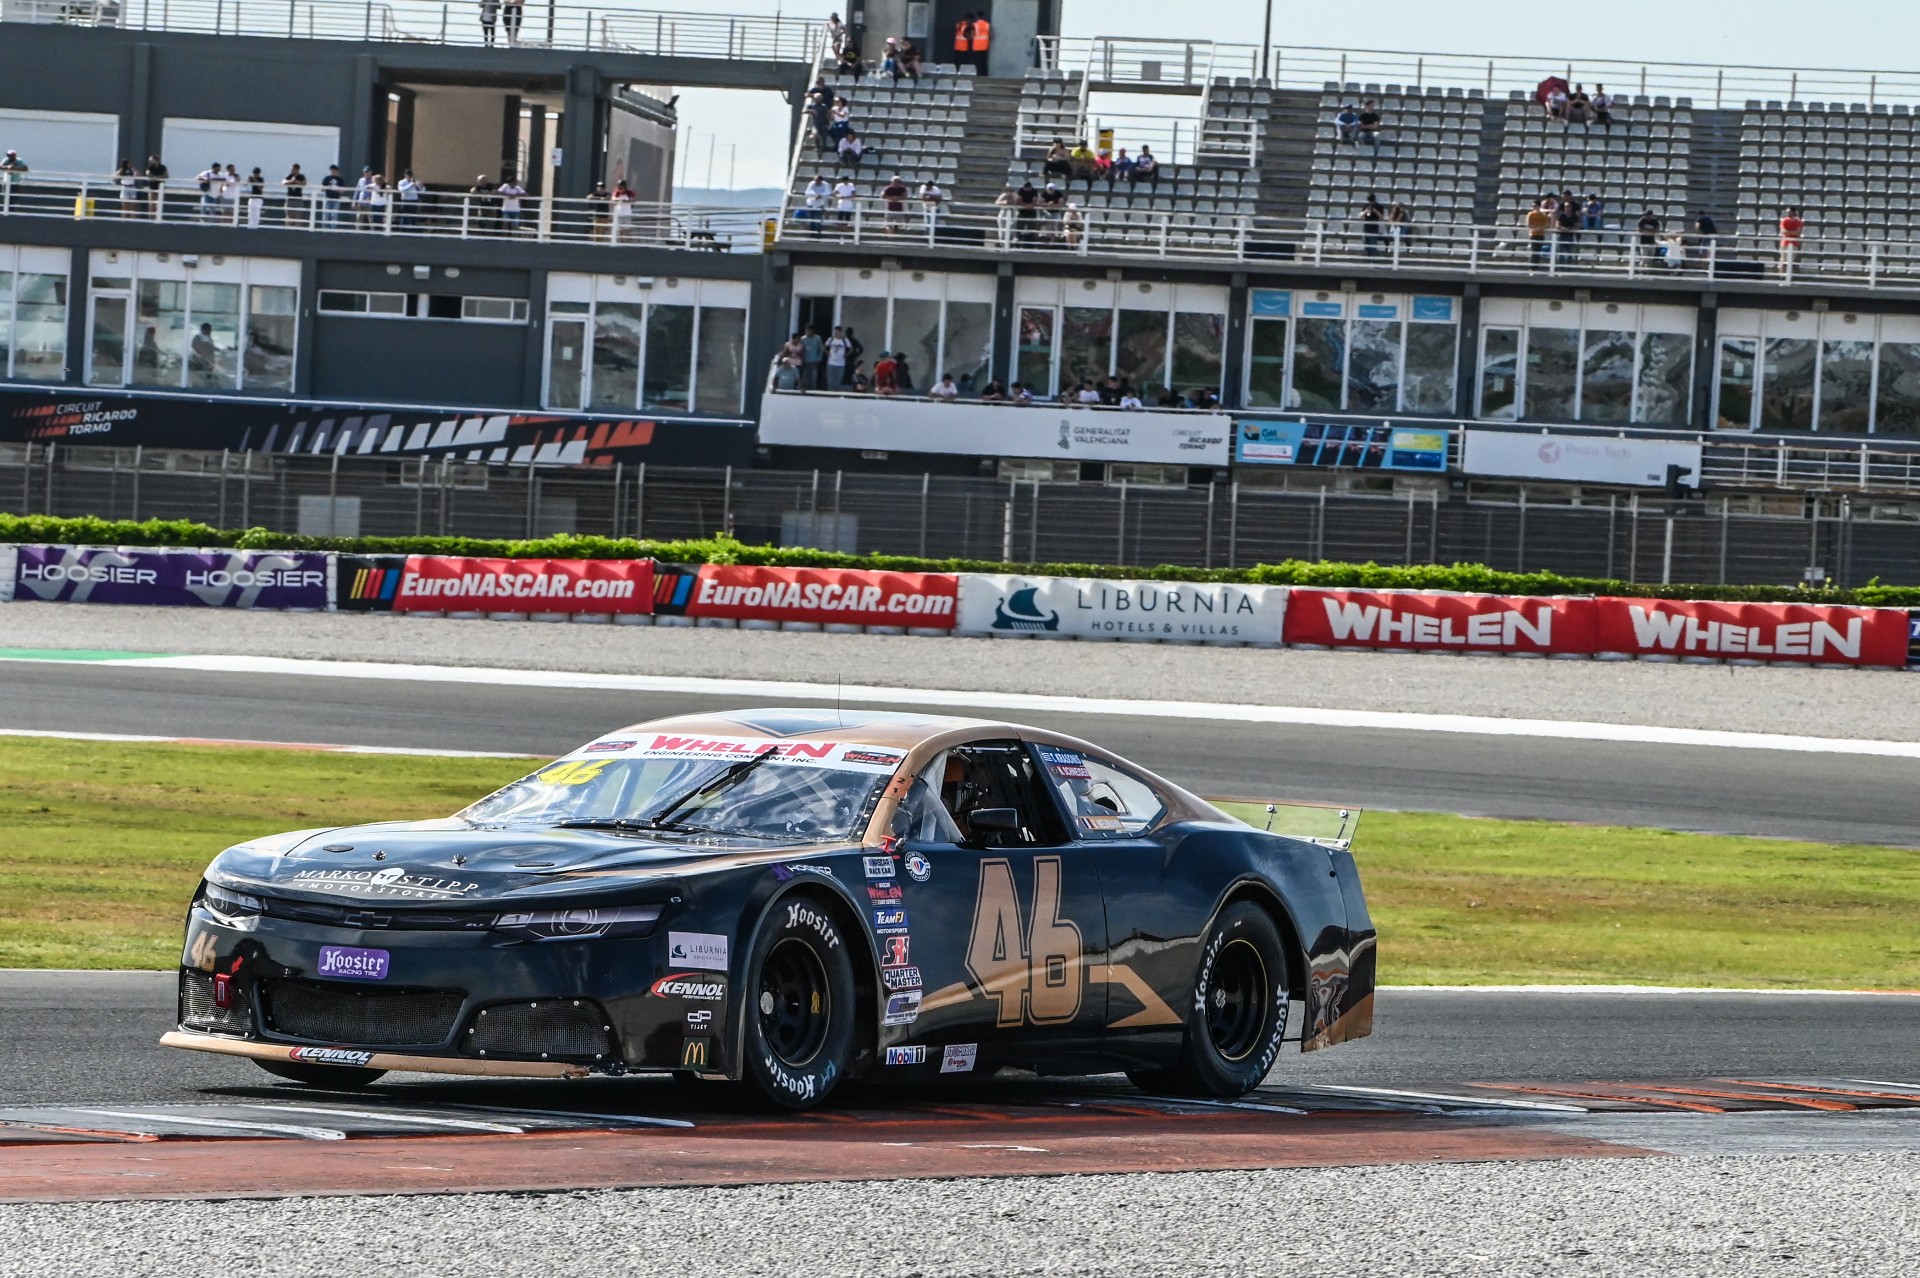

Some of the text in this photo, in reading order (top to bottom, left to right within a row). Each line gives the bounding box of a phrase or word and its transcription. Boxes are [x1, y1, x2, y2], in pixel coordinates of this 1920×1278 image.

[56, 401, 102, 415] CIRCUIT
[82, 409, 138, 423] RICARDO
[69, 422, 112, 435] TORMO
[1073, 426, 1131, 437] GENERALITAT
[1073, 435, 1129, 445] VALENCIANA
[20, 562, 158, 586] HOOSIER
[185, 567, 324, 589] HOOSIER
[402, 572, 635, 600] EuroNASCAR.com
[697, 578, 954, 615] EuroNASCAR.com
[1077, 588, 1255, 615] LIBURNIA
[1091, 620, 1240, 637] HOTELS & VILLAS
[1322, 597, 1553, 646] WHELEN
[1628, 605, 1864, 658] WHELEN
[643, 750, 723, 758] ENGINEERING
[725, 753, 789, 762] COMNY
[536, 759, 617, 785] 46
[294, 870, 479, 892] MARKO STIPP
[308, 882, 439, 899] MOTORSPORT
[785, 903, 839, 948] Hoosier
[690, 945, 727, 955] LIBURNIA
[964, 855, 1083, 1028] 46
[190, 930, 219, 973] 46
[322, 950, 385, 972] Hoosier
[364, 969, 379, 977] TIRE
[885, 969, 918, 983] QUARTER
[656, 981, 724, 996] KENNOL
[890, 977, 920, 989] MASTER
[296, 1046, 374, 1061] KENNOL
[888, 1047, 924, 1064] Mobil 1
